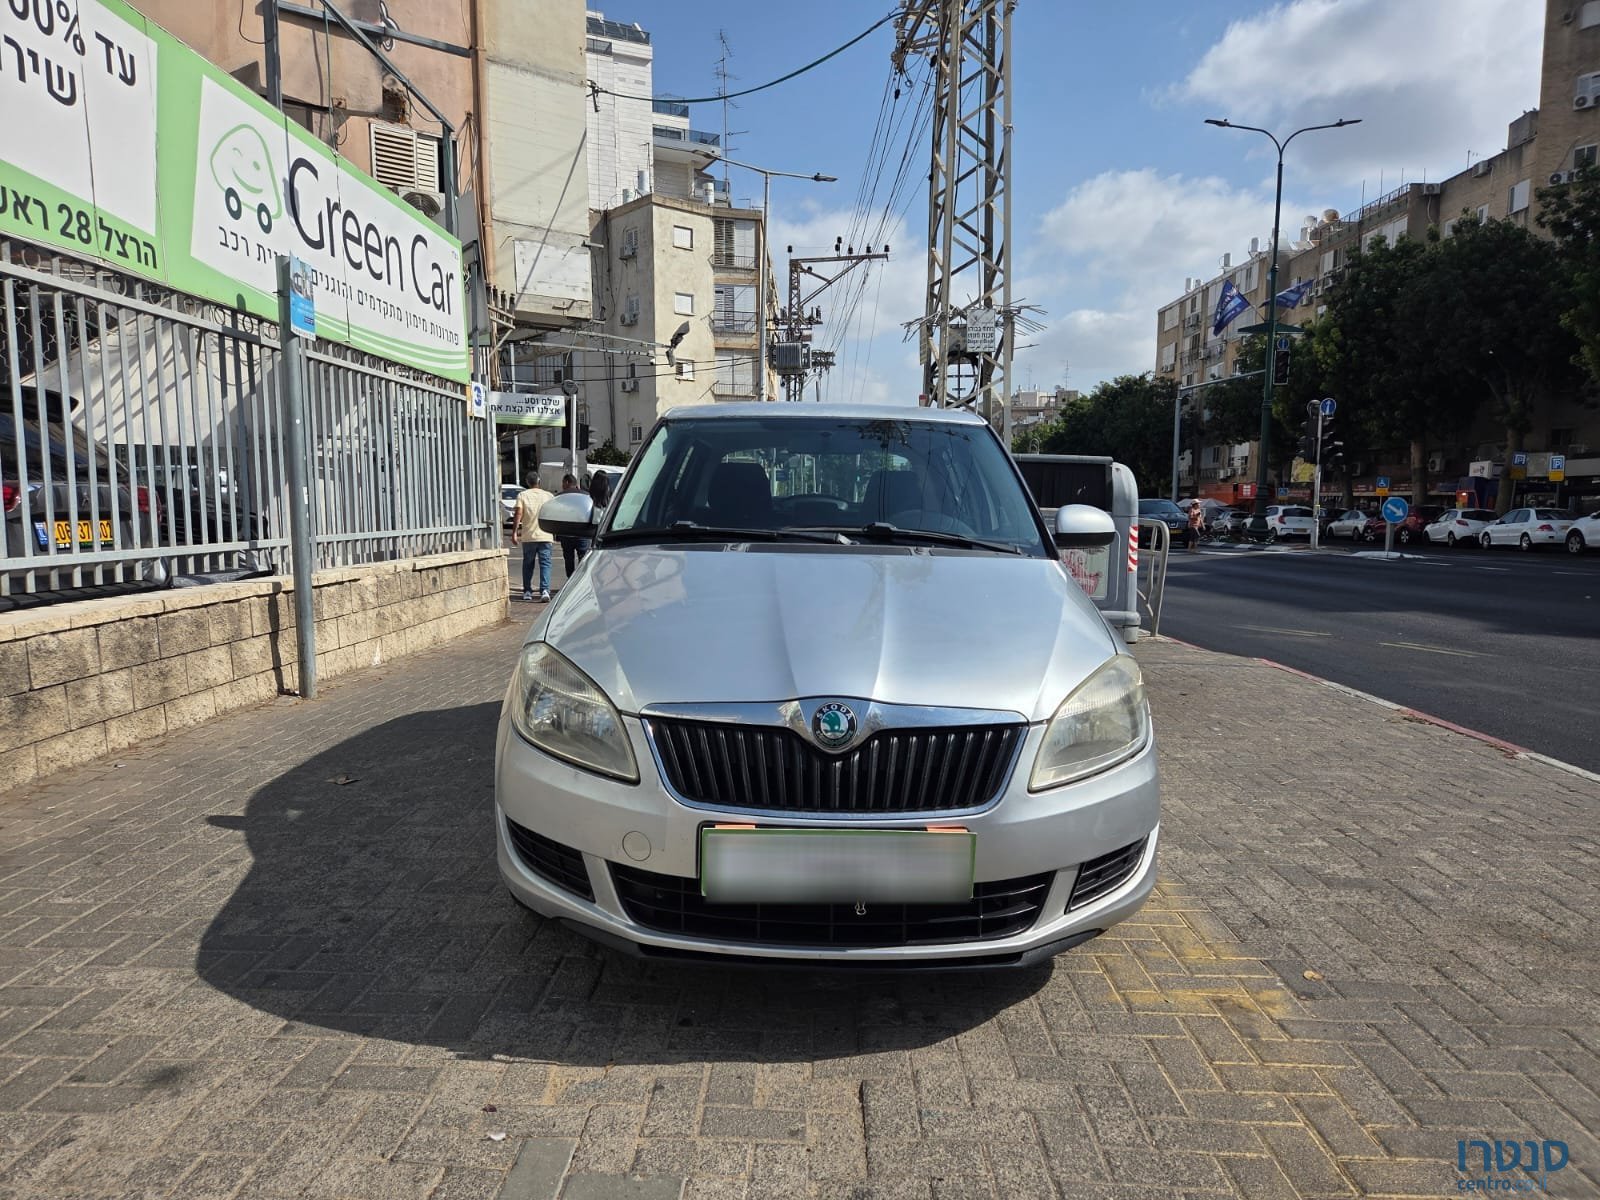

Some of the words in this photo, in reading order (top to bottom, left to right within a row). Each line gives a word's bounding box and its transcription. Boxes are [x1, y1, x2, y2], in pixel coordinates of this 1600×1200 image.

[0, 34, 77, 107] שיר
[95, 30, 136, 86] עד
[57, 203, 93, 245] 28
[288, 157, 404, 292] Green
[411, 234, 454, 315] Car
[98, 216, 158, 270] הרצל
[218, 225, 250, 257] רכב
[311, 268, 353, 301] והוגנים
[357, 288, 403, 322] מתקדמים
[405, 310, 428, 333] מימון
[430, 321, 459, 346] פתרונות
[505, 404, 523, 415] קצת
[537, 405, 561, 415] אצלנו
[541, 397, 560, 406] שלם
